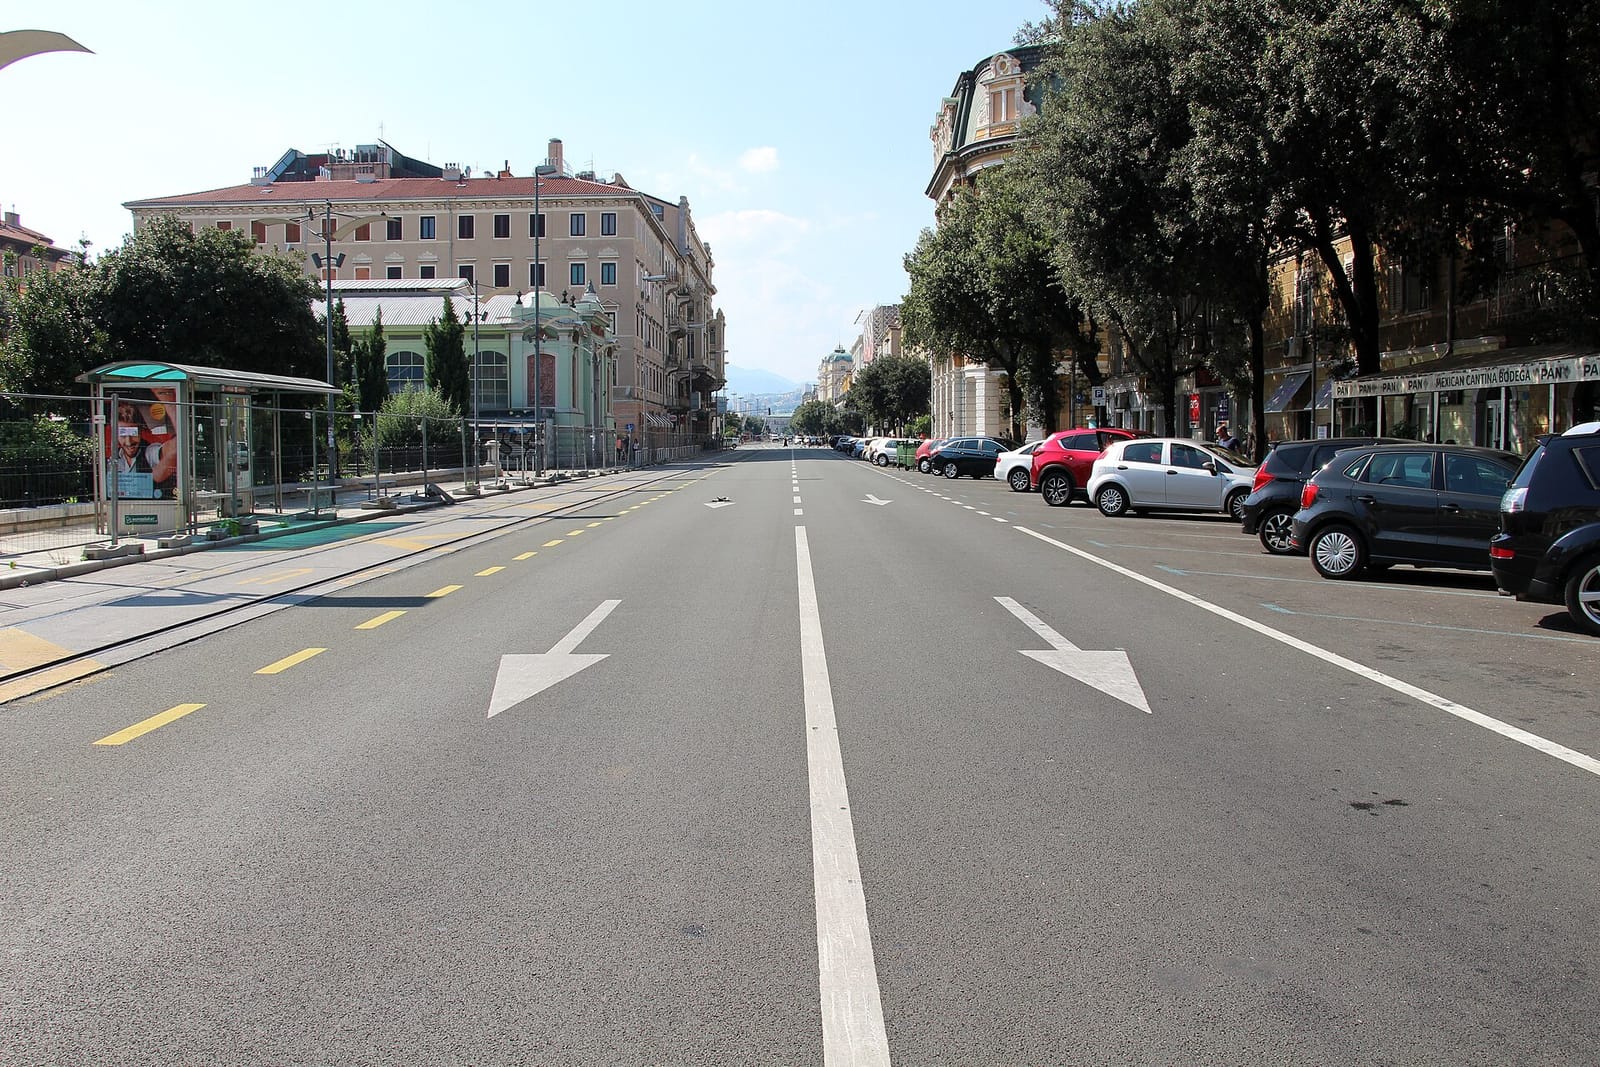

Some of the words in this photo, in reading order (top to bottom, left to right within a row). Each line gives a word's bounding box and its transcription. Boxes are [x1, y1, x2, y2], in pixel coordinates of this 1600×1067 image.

[1435, 376, 1465, 388] MEXICAN
[1466, 372, 1498, 386] CANTINA
[1500, 369, 1531, 382] BODEGA
[1541, 367, 1562, 380] PAN
[1360, 384, 1372, 393] PAN
[1382, 382, 1396, 392] PAN
[1408, 380, 1422, 390] PAN
[1336, 386, 1348, 396] PAN
